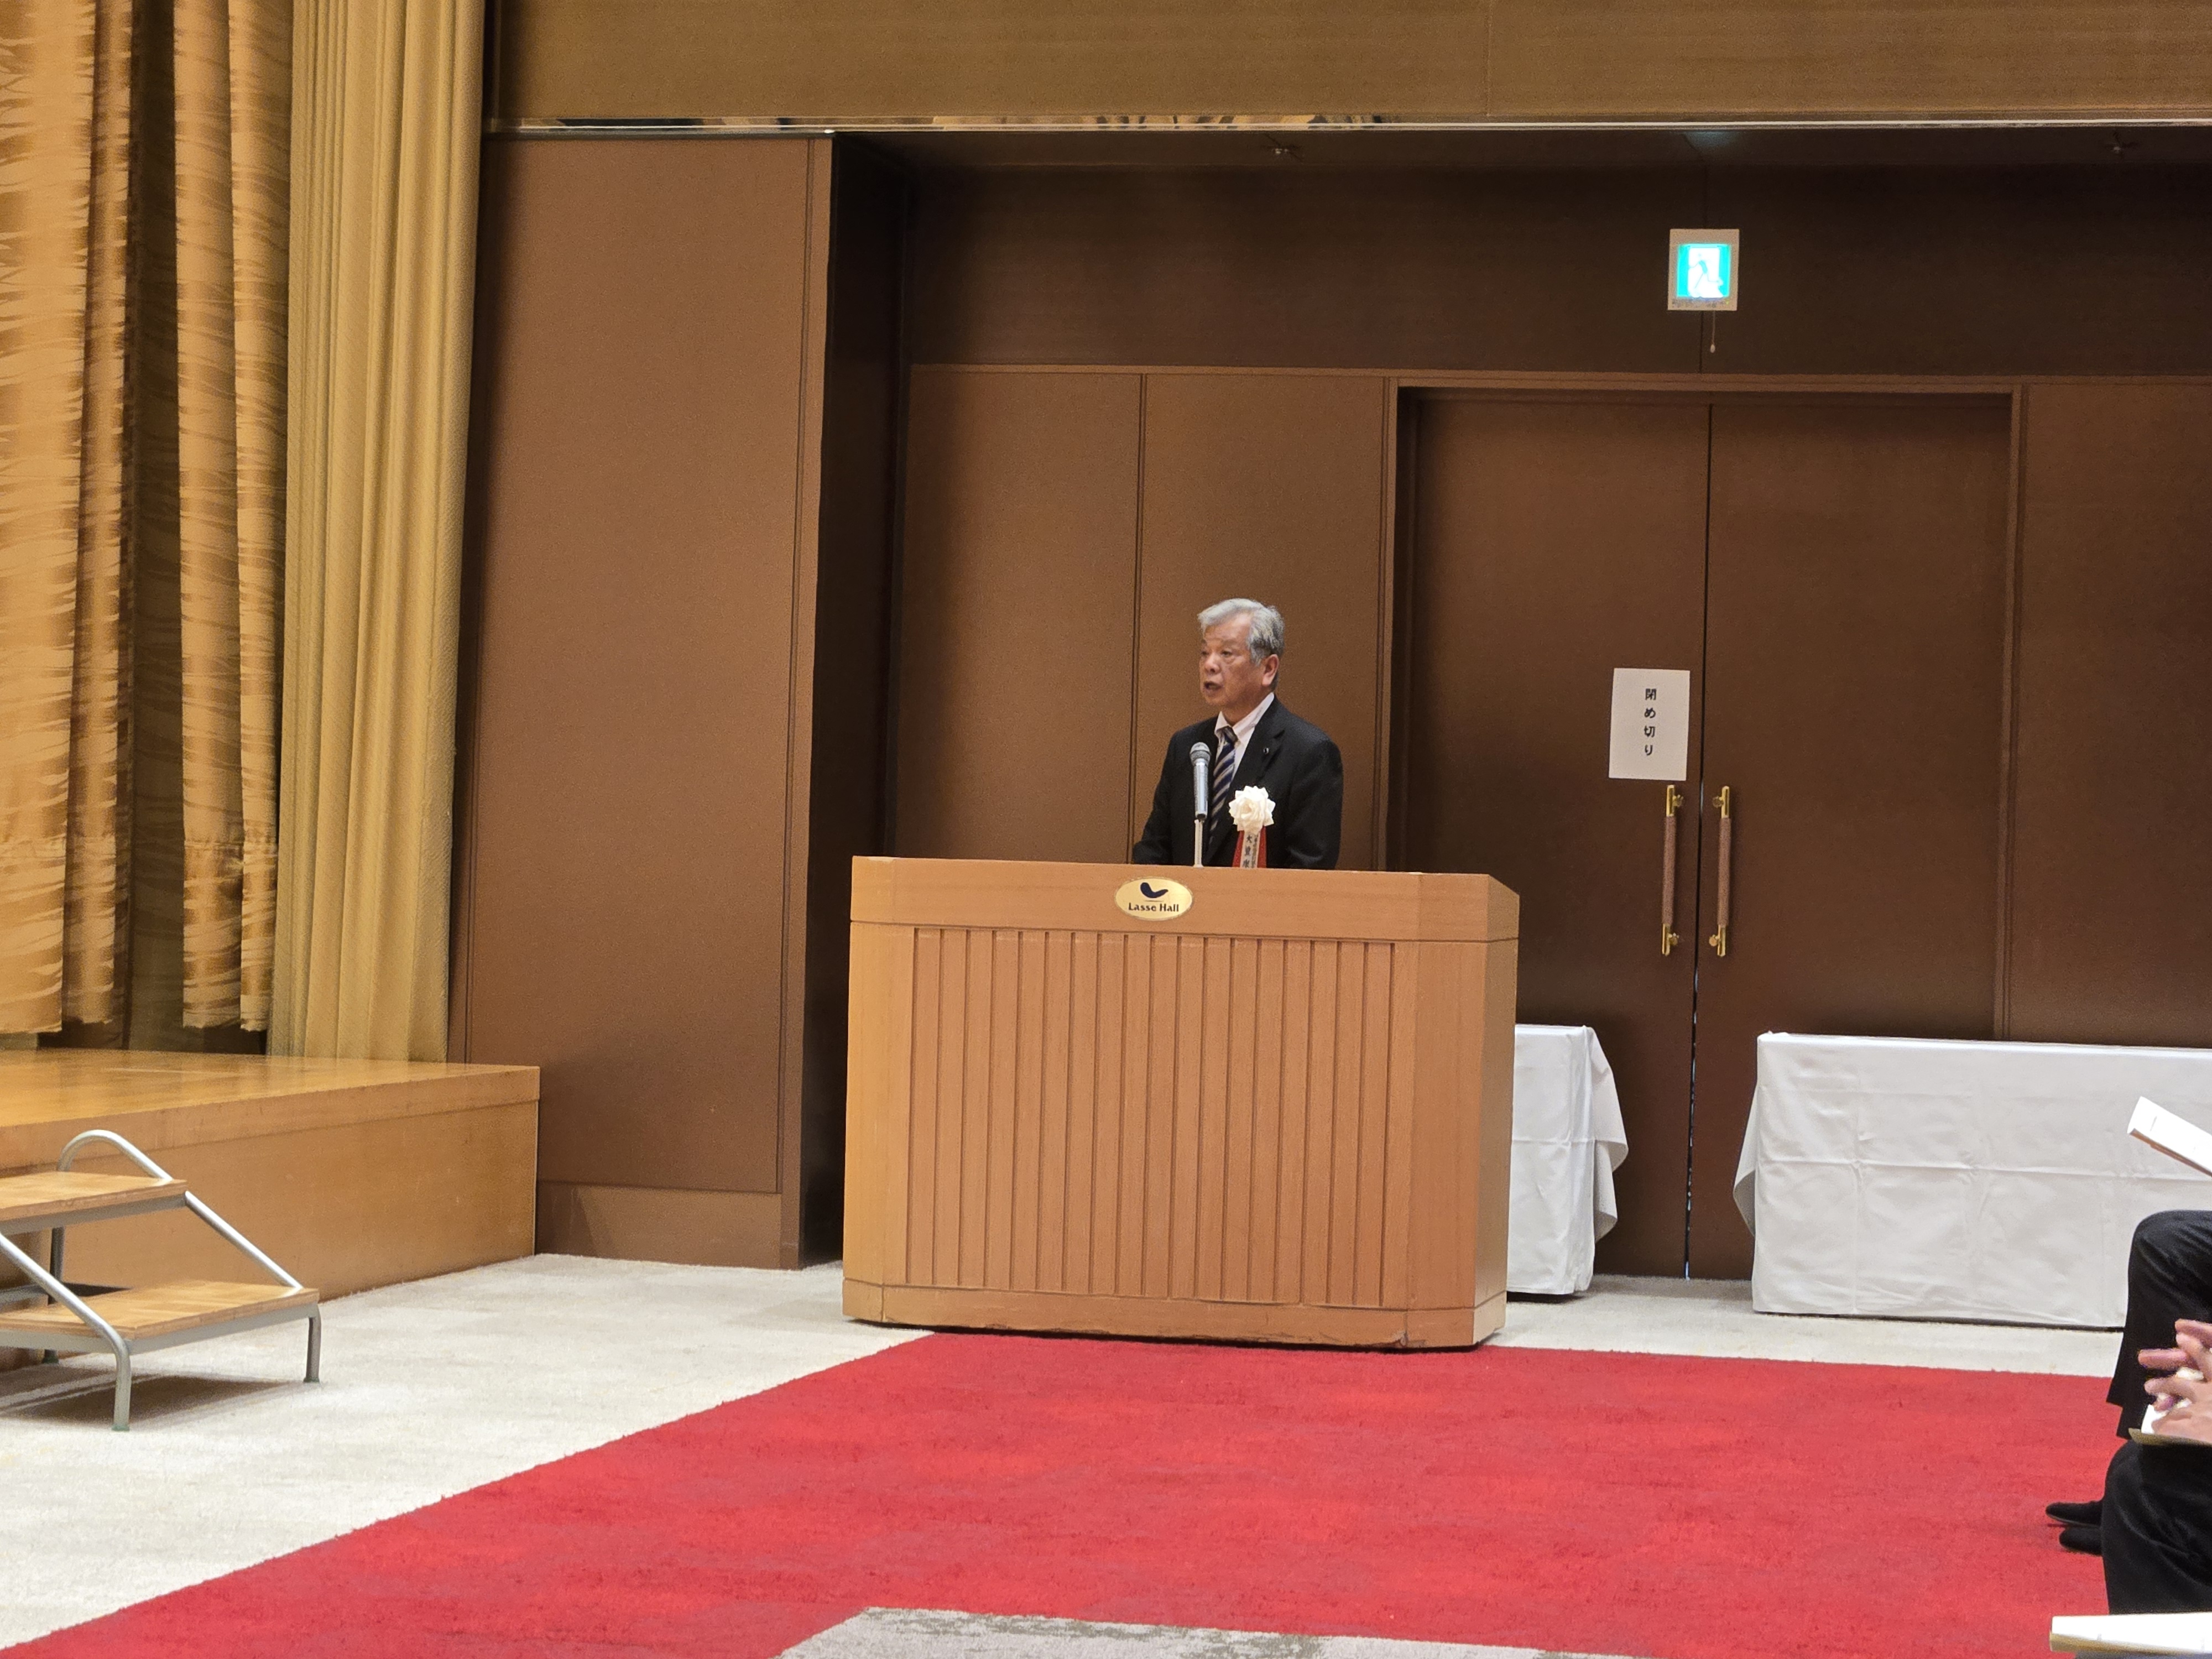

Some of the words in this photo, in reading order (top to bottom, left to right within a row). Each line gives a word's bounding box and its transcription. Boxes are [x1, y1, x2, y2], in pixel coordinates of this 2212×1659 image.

[1644, 688, 1656, 756] 閉め切り
[1129, 902, 1156, 911] Lasse
[1160, 903, 1179, 912] Hall
